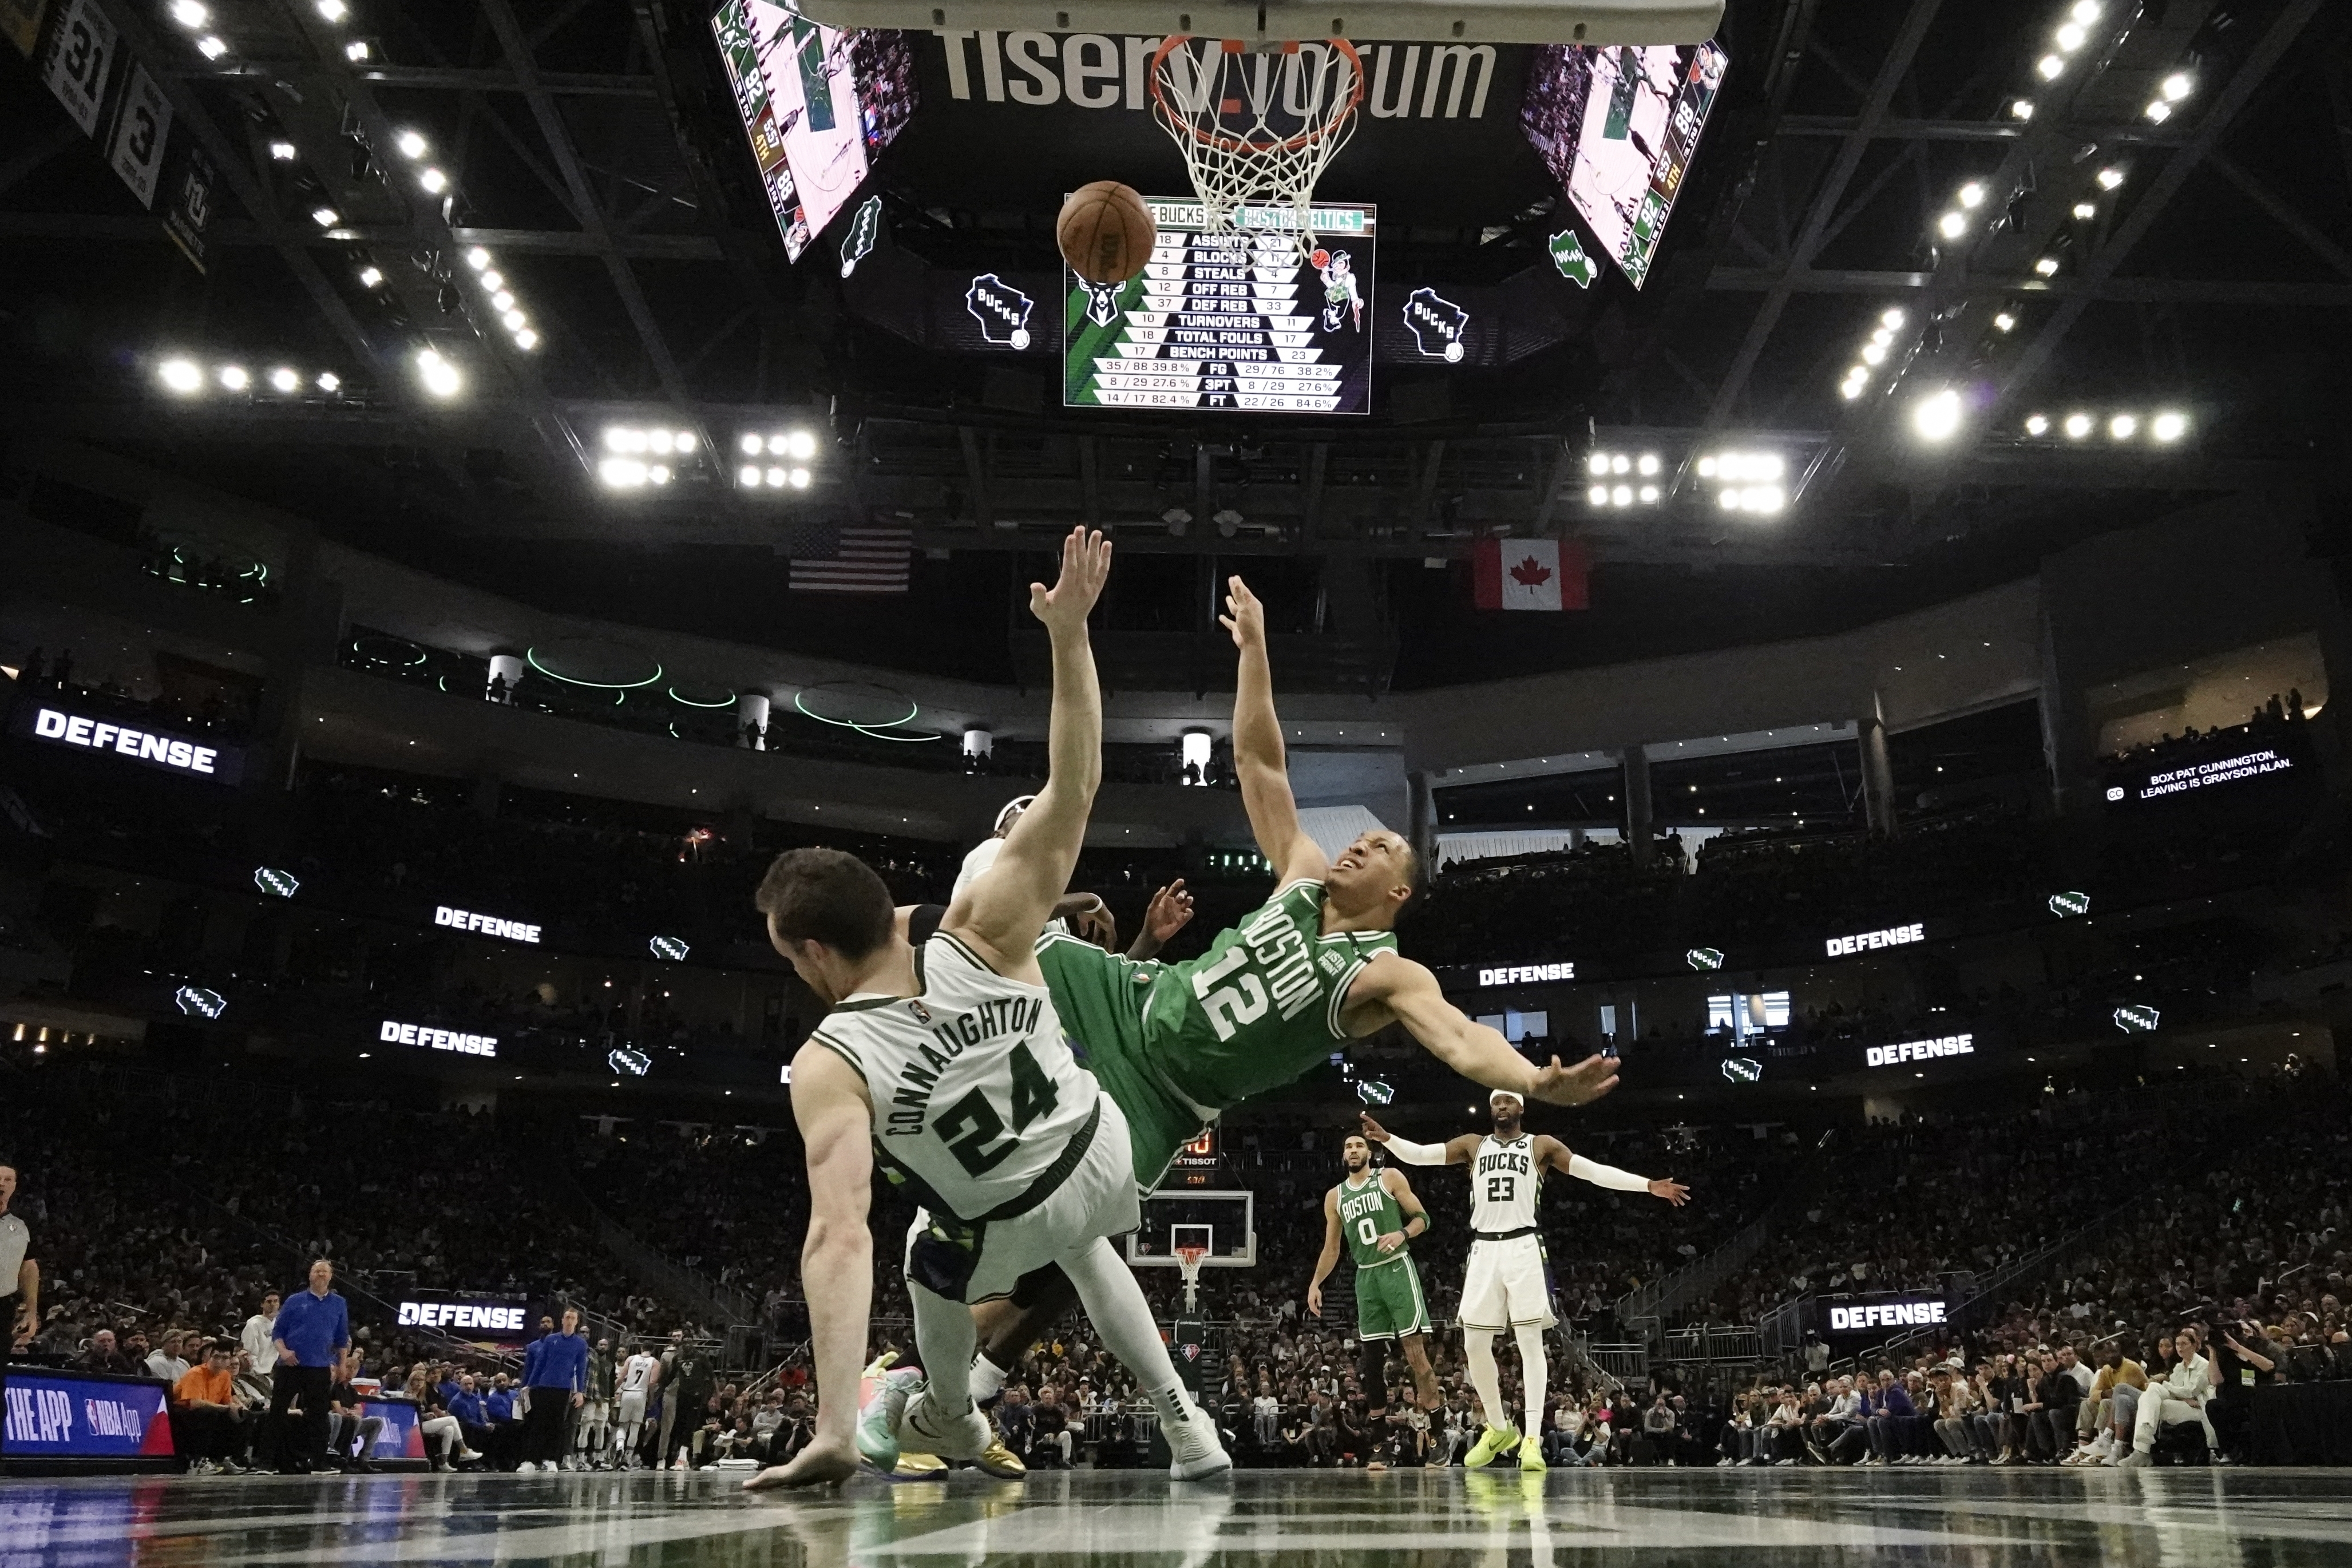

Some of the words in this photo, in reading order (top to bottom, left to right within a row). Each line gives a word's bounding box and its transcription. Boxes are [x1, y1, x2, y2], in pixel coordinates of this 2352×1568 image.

[65, 21, 103, 102] 31
[745, 67, 764, 104] 92
[1675, 101, 1693, 135] 88
[130, 105, 156, 166] 3
[764, 117, 779, 148] 5:57
[756, 134, 770, 161] 4TH
[1657, 150, 1671, 182] 5:57
[777, 169, 794, 200] 88
[1667, 164, 1681, 190] 4TH
[1159, 206, 1204, 223] BUCKS
[1306, 209, 1354, 229] ELTICS
[1641, 197, 1658, 228] 92
[855, 205, 872, 257] BUCKS
[1159, 235, 1171, 244] 18
[1192, 235, 1249, 248] ASSISTS
[1162, 251, 1169, 259] 4
[1194, 251, 1247, 264] BLOCKS
[1556, 248, 1583, 264] BUCKS
[1162, 267, 1168, 275] 8
[1195, 267, 1246, 280] STEALS
[1159, 283, 1171, 291] 12
[1192, 283, 1218, 295] OFF
[1221, 284, 1248, 296] REB
[1272, 286, 1277, 294] 7
[977, 288, 1020, 326] BUCKS
[1158, 299, 1171, 307] 37
[1192, 299, 1218, 310] DEF
[1221, 300, 1248, 312] REB
[1266, 302, 1281, 310] 33
[1142, 314, 1154, 323] 10
[1178, 315, 1260, 328] TURNOVERS
[1287, 318, 1296, 327] 11
[1415, 302, 1454, 339] BUCKS
[1142, 331, 1154, 339] 18
[1175, 330, 1217, 343] TOTAL
[1219, 331, 1262, 344] FOULS
[1285, 335, 1296, 343] 17
[1134, 347, 1146, 355] 17
[1170, 346, 1215, 359] BENCH
[1219, 347, 1268, 360] POINTS
[1292, 351, 1306, 360] 23
[1107, 362, 1120, 370] 35
[1134, 363, 1147, 371] 88
[1152, 363, 1178, 371] 39.8
[1210, 363, 1227, 375] FG
[1245, 365, 1259, 374] 29
[1272, 366, 1285, 375] 76
[1110, 377, 1117, 386] 8
[1133, 378, 1147, 386] 29
[1153, 378, 1177, 387] 27.6
[1205, 379, 1231, 391] 3PT
[1248, 381, 1254, 390] 8
[1270, 382, 1284, 390] 29
[1107, 393, 1119, 402] 14
[1134, 394, 1146, 403] 17
[1152, 395, 1177, 404] 82.4
[1210, 395, 1226, 406] FT
[1244, 398, 1258, 406] 22
[1270, 398, 1284, 407] 26
[35, 708, 217, 774] DEFENSE
[2151, 773, 2175, 785] BOX
[2176, 767, 2196, 780] PAT
[2199, 750, 2278, 775] CUNNINGTON.
[2140, 781, 2187, 799] LEAVING
[2189, 778, 2200, 788] IS
[2203, 765, 2258, 785] GRAYSON
[2259, 758, 2294, 774] ALAN.
[2109, 789, 2122, 799] CC
[263, 869, 289, 896] BUCKS
[2056, 896, 2083, 914] BUCKS
[434, 906, 541, 943] DEFENSE
[657, 937, 680, 960] BUCKS
[1826, 923, 1925, 957] DEFENSE
[1241, 902, 1324, 1022] BOSTON
[1693, 951, 1717, 968] BUCKS
[1479, 963, 1575, 986] DEFENSE
[185, 988, 215, 1017] BUCKS
[1191, 945, 1269, 1043] 12
[2121, 1009, 2152, 1030] BUCKS
[380, 1021, 497, 1057] DEFENSE
[1866, 1034, 1974, 1067] DEFENSE
[616, 1051, 642, 1075] BUCKS
[885, 997, 1043, 1136] CONNAUGHTON
[1728, 1061, 1755, 1081] BUCKS
[1364, 1083, 1386, 1103] BUCKS
[931, 1039, 1059, 1179] 24
[1479, 1153, 1529, 1177] BUCKS
[1488, 1177, 1514, 1202] 23
[1341, 1191, 1384, 1222] BOSTON
[1358, 1218, 1378, 1245] 0
[398, 1302, 525, 1330] DEFENSE
[1831, 1301, 1947, 1329] DEFENSE
[635, 1369, 644, 1384] 7
[5, 1387, 39, 1441] THE
[37, 1389, 73, 1442] APP
[95, 1400, 123, 1436] NBA
[120, 1401, 142, 1443] App
